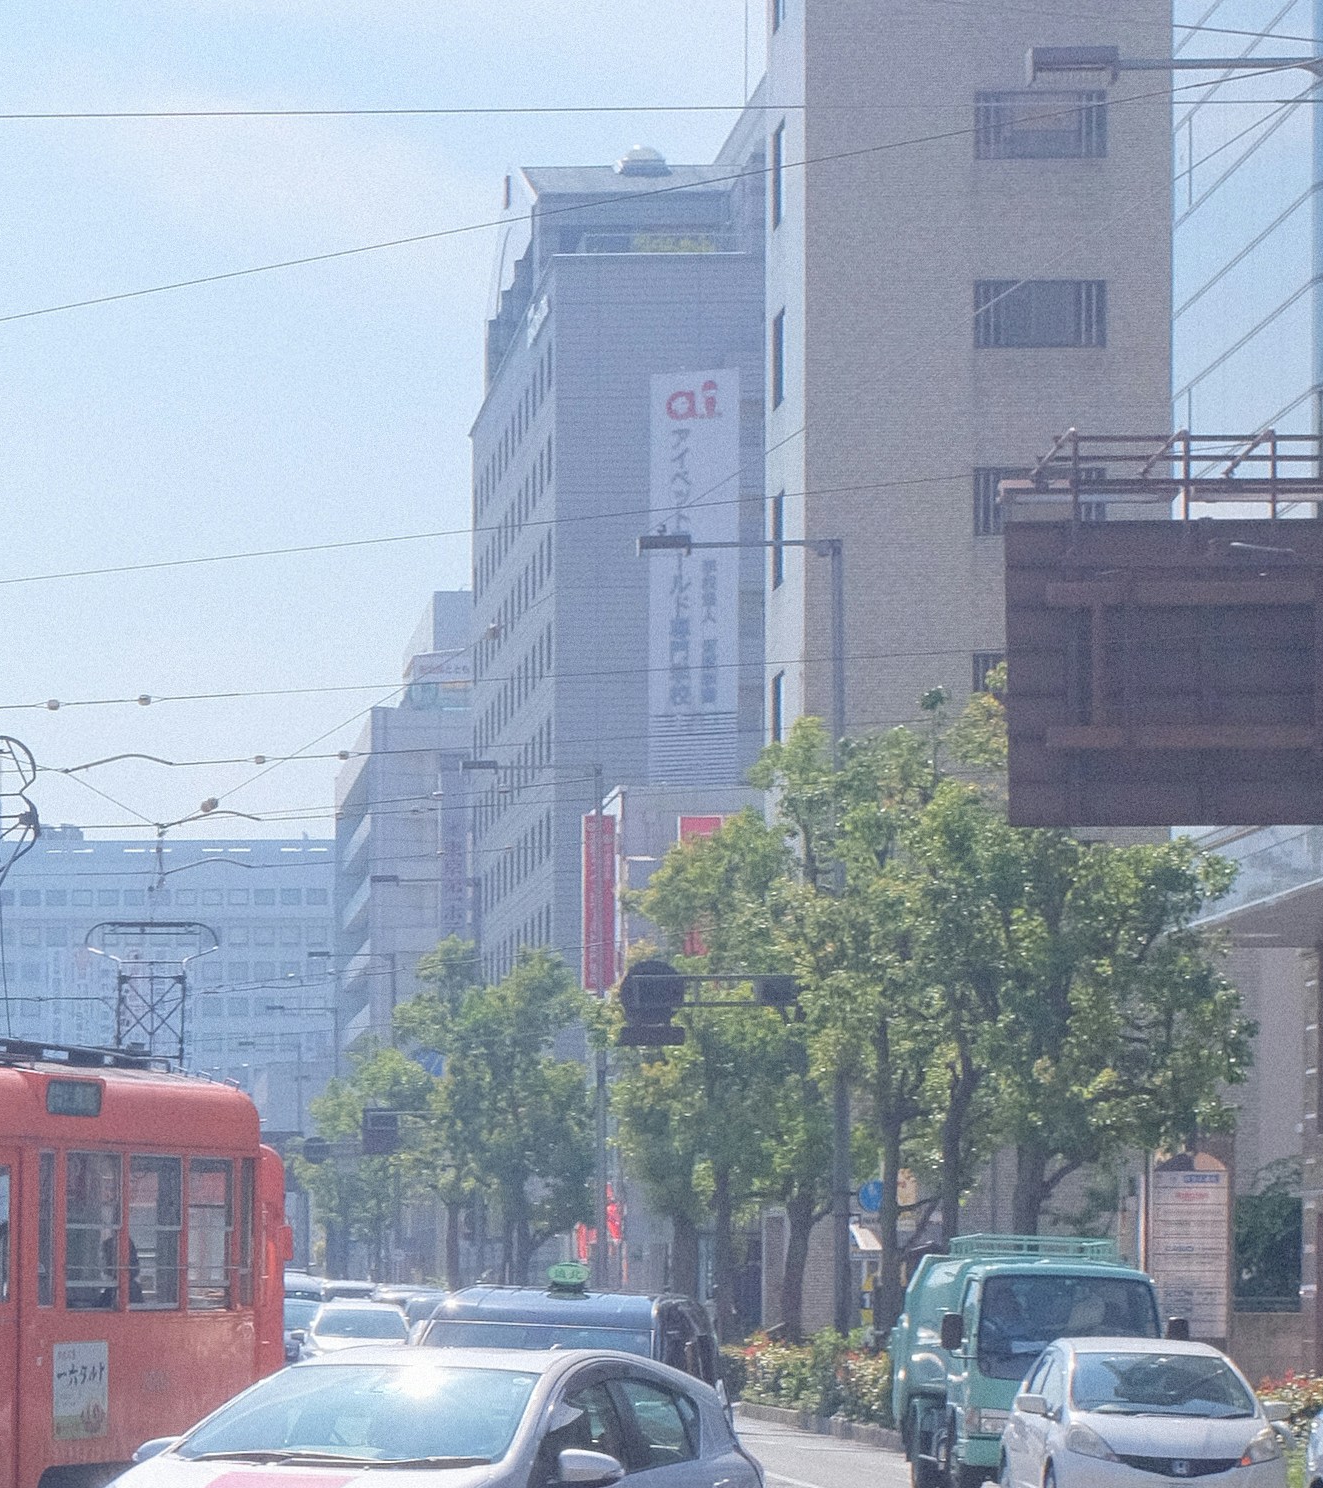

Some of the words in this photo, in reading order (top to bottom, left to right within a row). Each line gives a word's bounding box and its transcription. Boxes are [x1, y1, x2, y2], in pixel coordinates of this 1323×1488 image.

[670, 429, 693, 706] アイペットールド専門学校
[56, 1363, 105, 1386] 一六タルト
